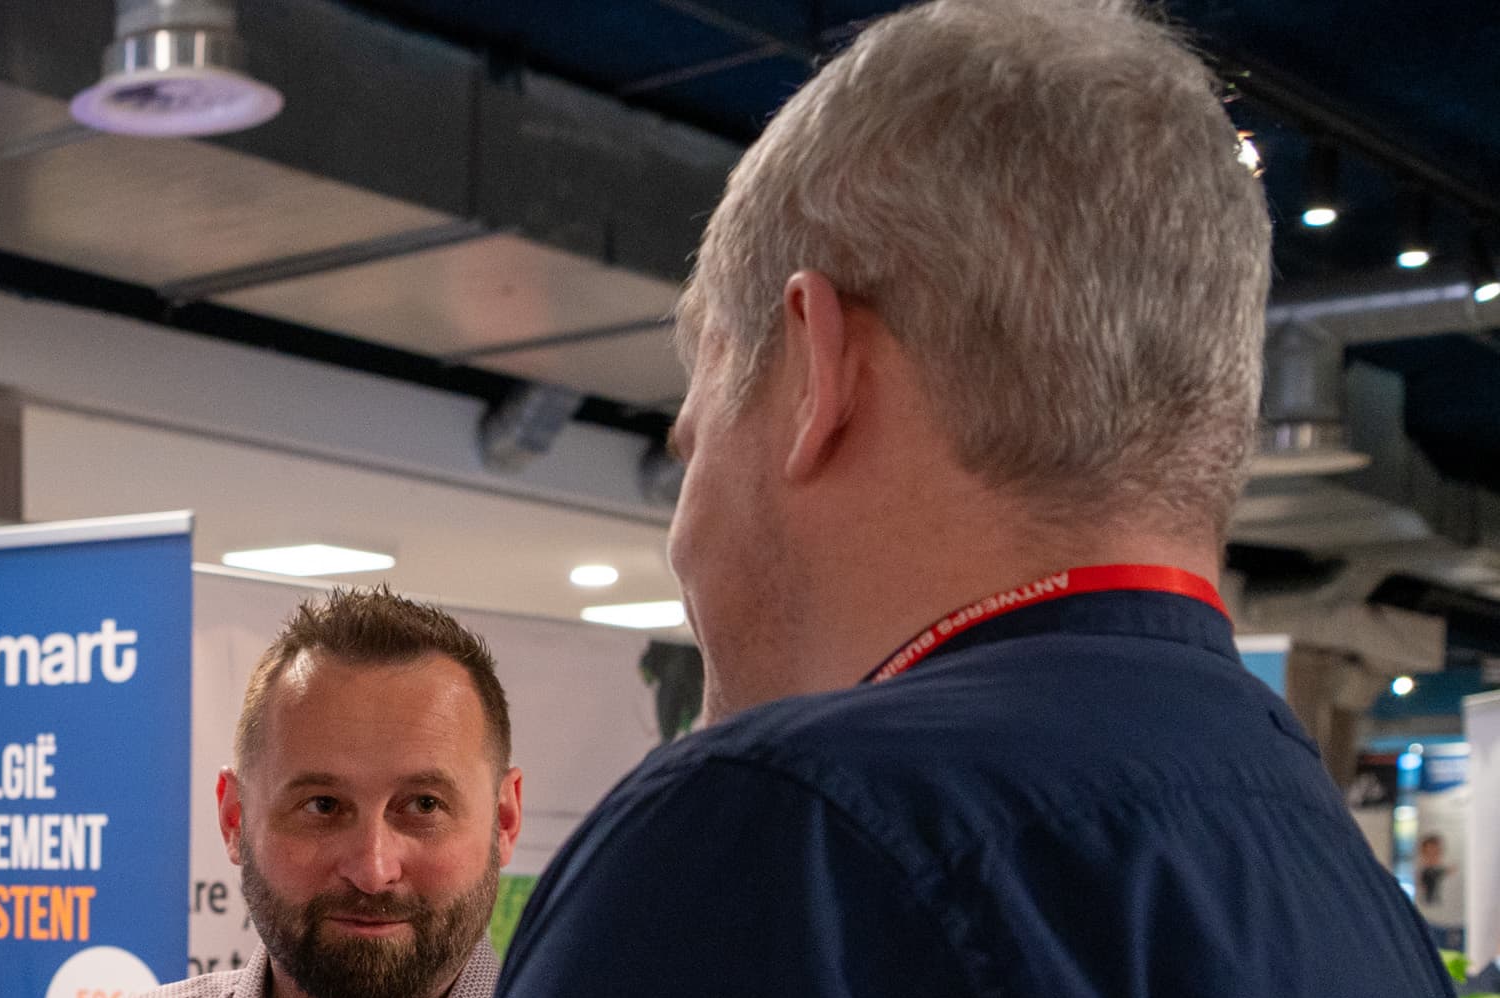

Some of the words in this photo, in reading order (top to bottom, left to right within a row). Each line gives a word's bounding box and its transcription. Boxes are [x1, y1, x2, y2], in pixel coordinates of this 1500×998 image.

[937, 572, 1069, 636] ANTWERPS
[872, 630, 936, 684] BUSIN
[189, 881, 228, 914] re
